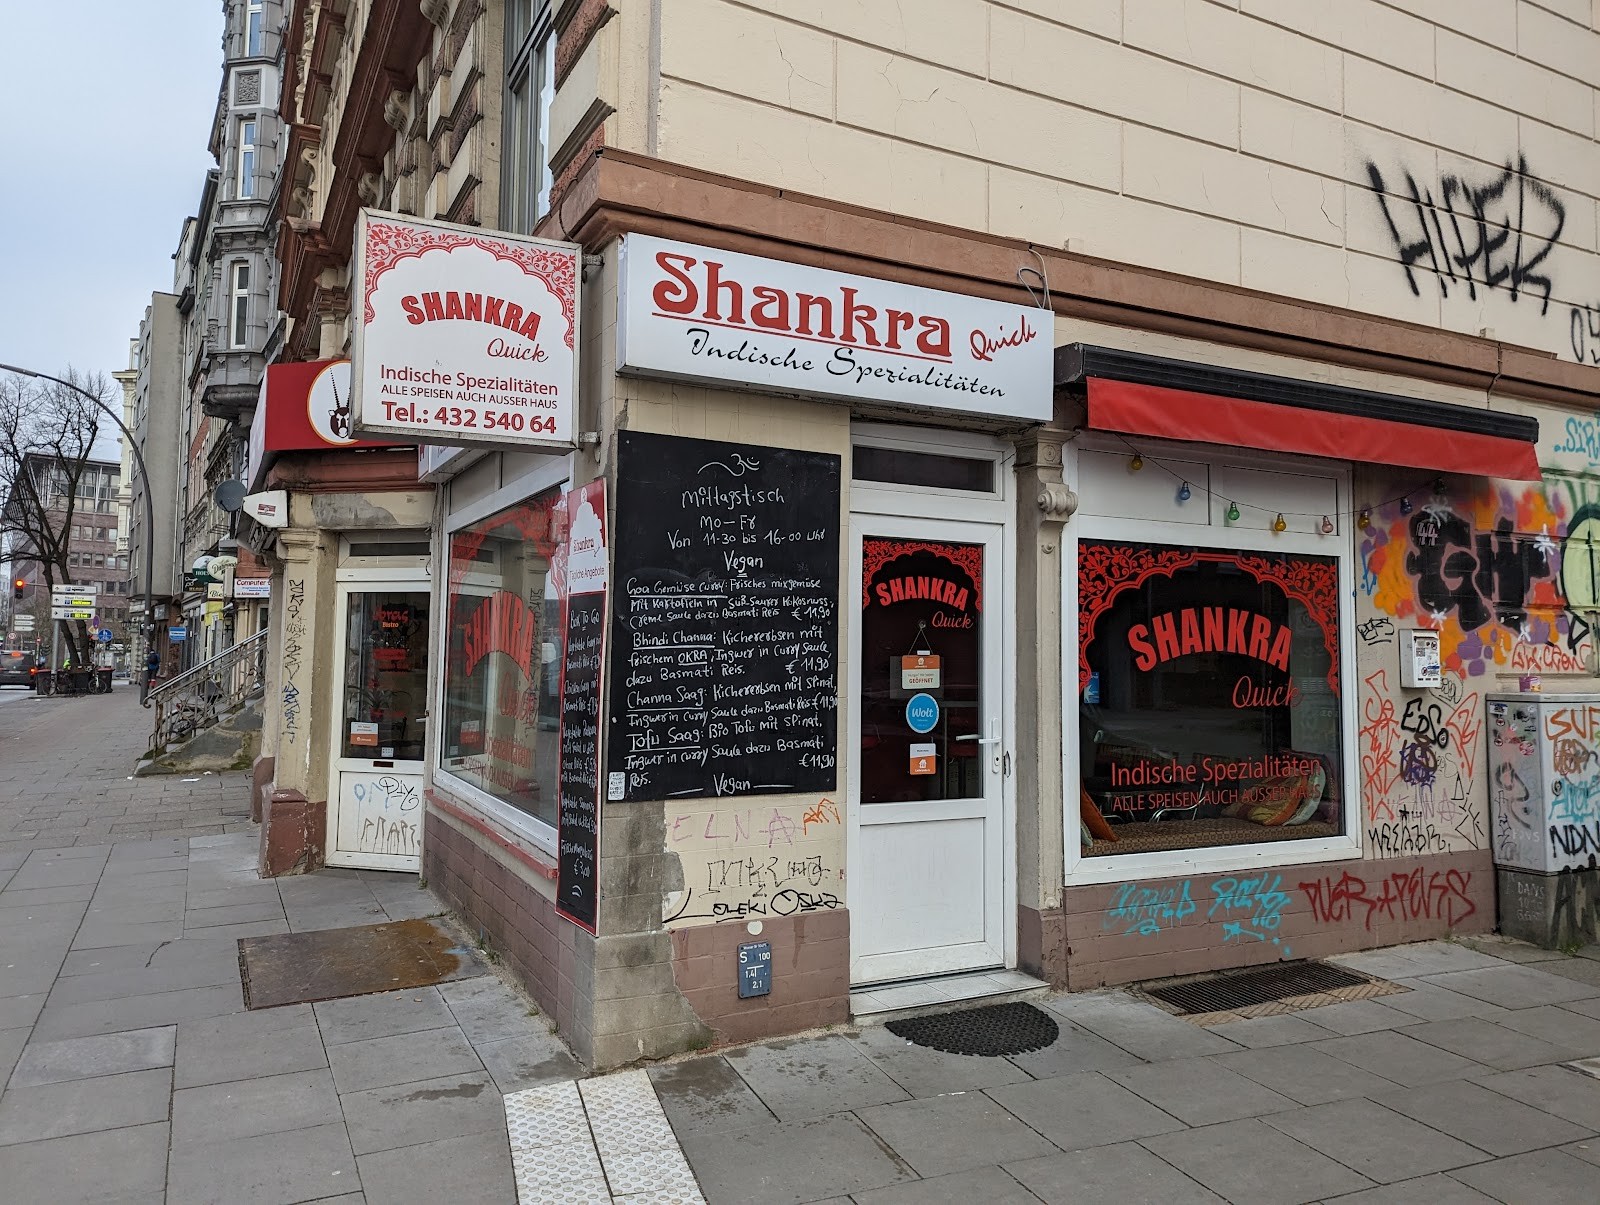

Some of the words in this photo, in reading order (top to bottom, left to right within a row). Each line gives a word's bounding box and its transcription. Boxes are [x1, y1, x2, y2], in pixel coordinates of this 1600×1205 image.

[401, 292, 541, 341] SHANKRA
[652, 251, 952, 357] Shankra
[970, 315, 1037, 361] Quick
[487, 338, 549, 363] Quick
[686, 328, 815, 371] Indische
[825, 348, 1006, 397] Spezialitäten
[381, 365, 452, 385] Indische
[457, 372, 558, 396] Spezialitäten
[381, 384, 408, 396] ALLE
[411, 387, 453, 400] SPEISEN
[456, 391, 486, 403] AUCH
[489, 395, 528, 407] AUSSER
[530, 398, 557, 409] HAUS
[382, 401, 428, 424] Tel.:
[434, 406, 477, 428] 432
[484, 412, 524, 431] 540
[529, 415, 557, 434] 64
[682, 484, 784, 509] Mittagstisch
[668, 529, 691, 550] Von
[742, 533, 757, 544] bis
[723, 550, 763, 573] Vegan
[627, 577, 650, 594] Goa
[654, 581, 695, 594] Gemüse
[730, 578, 766, 591] Frisches
[876, 576, 969, 612] SHANKRA
[706, 597, 717, 607] in
[722, 607, 759, 619] Basmati
[804, 606, 830, 619] 11,90
[931, 610, 974, 629] Quick
[464, 590, 535, 682] SHANKRA
[633, 631, 669, 648] Bhindi
[673, 630, 716, 644] Channa:
[723, 629, 795, 645] Kichererbsen
[800, 625, 822, 638] mit
[1128, 607, 1292, 672] SHANKRA
[628, 652, 673, 667] frischem
[758, 645, 769, 657] in
[774, 643, 800, 658] Curry
[626, 670, 652, 687] dazu
[660, 665, 713, 680] Basmati
[721, 663, 745, 676] Reis.
[785, 660, 799, 674] €
[801, 657, 829, 671] 11,90
[627, 691, 672, 708] Channa
[785, 676, 802, 691] mit
[1232, 676, 1303, 709] Quick
[626, 713, 668, 728] Ingwer
[669, 712, 678, 721] in
[683, 710, 708, 727] Curry
[764, 697, 796, 713] Basmati
[912, 707, 933, 718] Wolt
[626, 729, 659, 751] Tofu
[709, 723, 728, 738] Bio
[731, 719, 755, 734] Tofu
[760, 716, 778, 730] mit
[624, 754, 664, 770] Ingwer
[667, 752, 676, 763] in
[681, 748, 708, 767] Curry
[745, 742, 771, 754] dazu
[777, 735, 824, 751] Basmati
[713, 773, 750, 796] Vegan
[1111, 760, 1197, 786] Indische
[1202, 755, 1321, 785] Spezialitäten
[1113, 795, 1145, 811] ALLE
[1149, 792, 1201, 809] SPEISEN
[1205, 788, 1238, 805] AUCH
[1242, 786, 1286, 803] AUSSER
[1289, 783, 1321, 799] HAUS
[740, 951, 748, 963] S
[758, 952, 771, 961] 100
